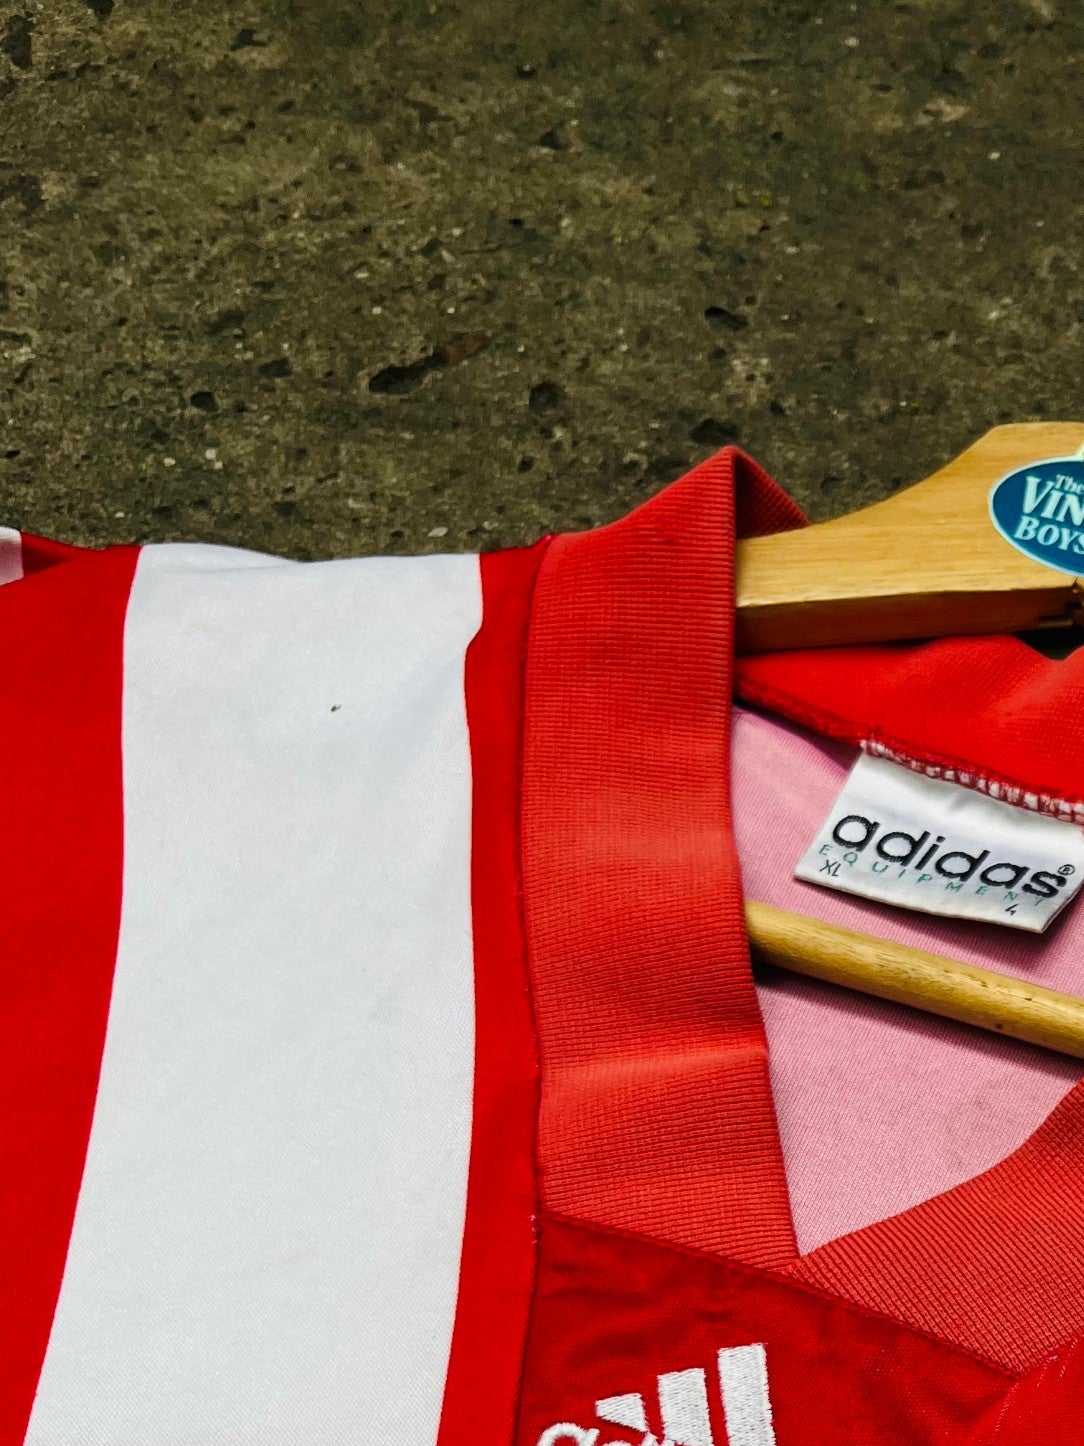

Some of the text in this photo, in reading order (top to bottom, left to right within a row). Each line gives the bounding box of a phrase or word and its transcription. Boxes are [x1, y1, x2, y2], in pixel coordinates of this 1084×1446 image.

[818, 859, 842, 878] XL
[818, 843, 1047, 908] EQUIPMENT
[1004, 903, 1019, 916] 4
